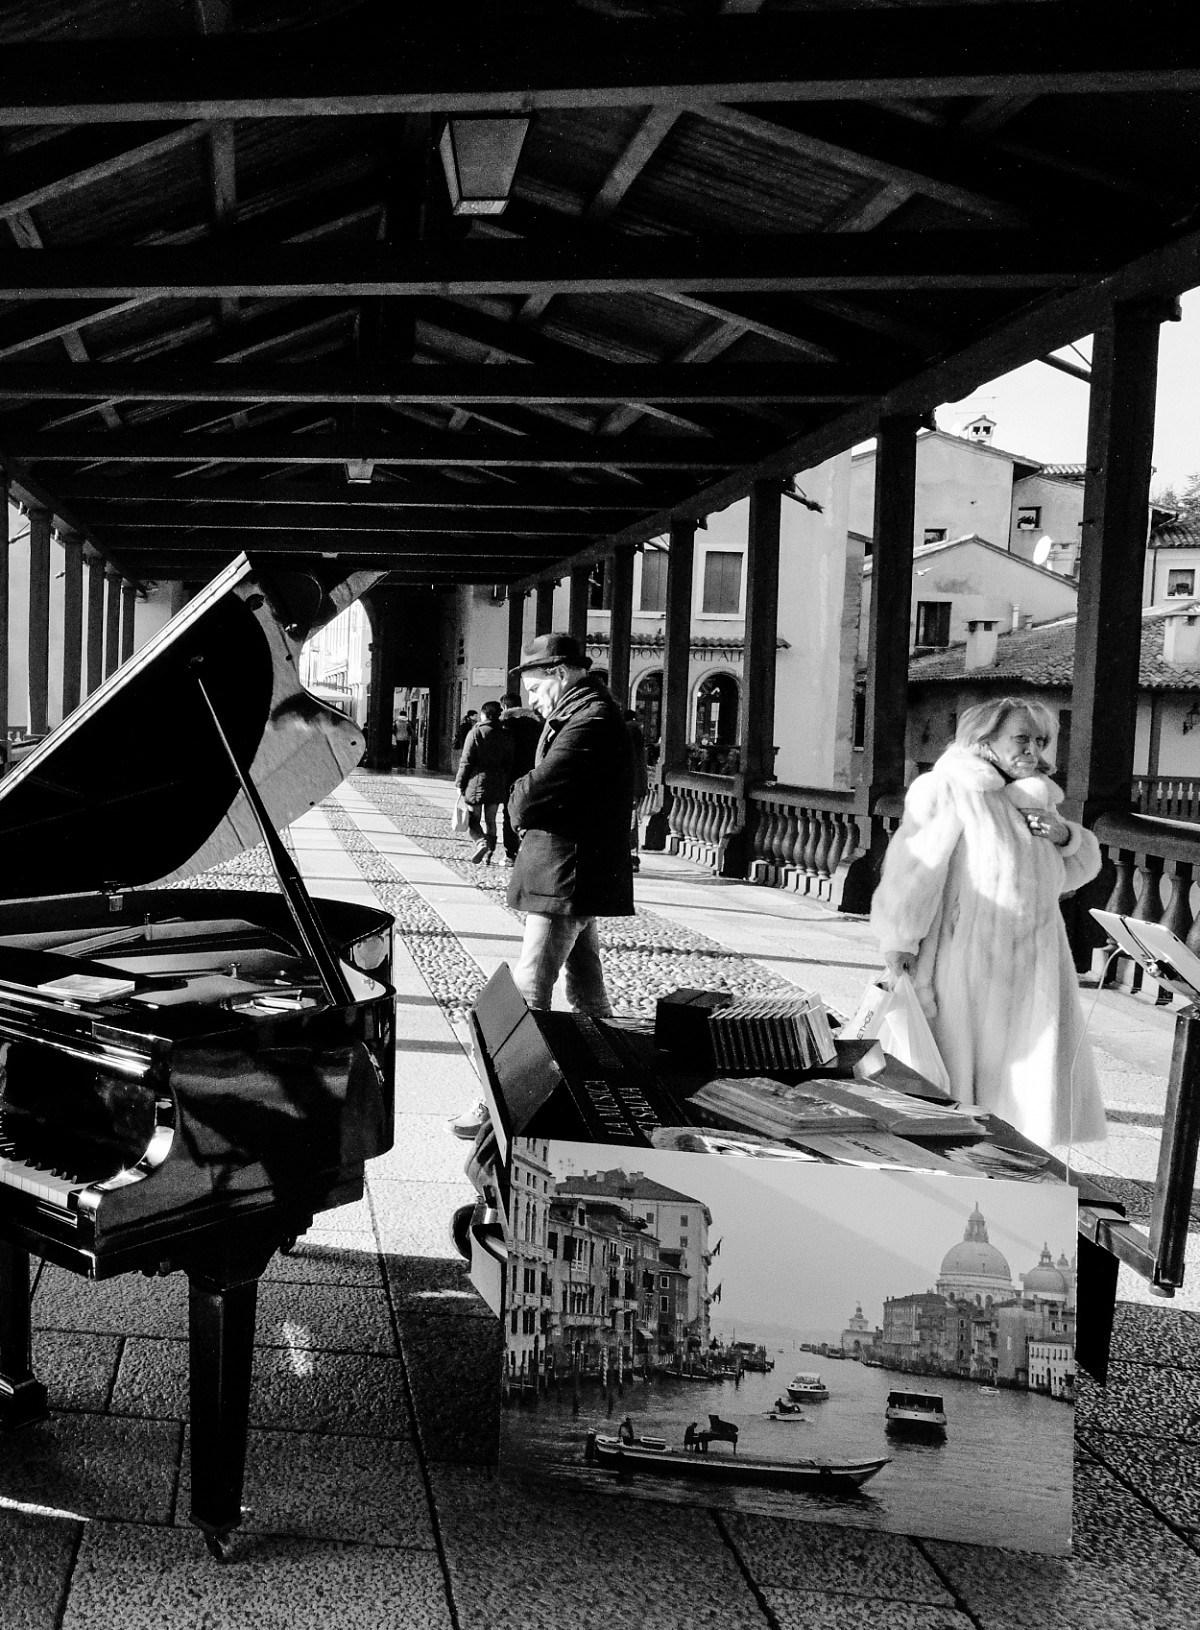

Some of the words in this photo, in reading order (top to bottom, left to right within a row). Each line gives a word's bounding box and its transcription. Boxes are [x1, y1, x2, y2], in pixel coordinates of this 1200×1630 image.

[584, 1080, 624, 1119] MUSICA
[618, 1087, 658, 1119] SALVA
[604, 1122, 635, 1137] LA
